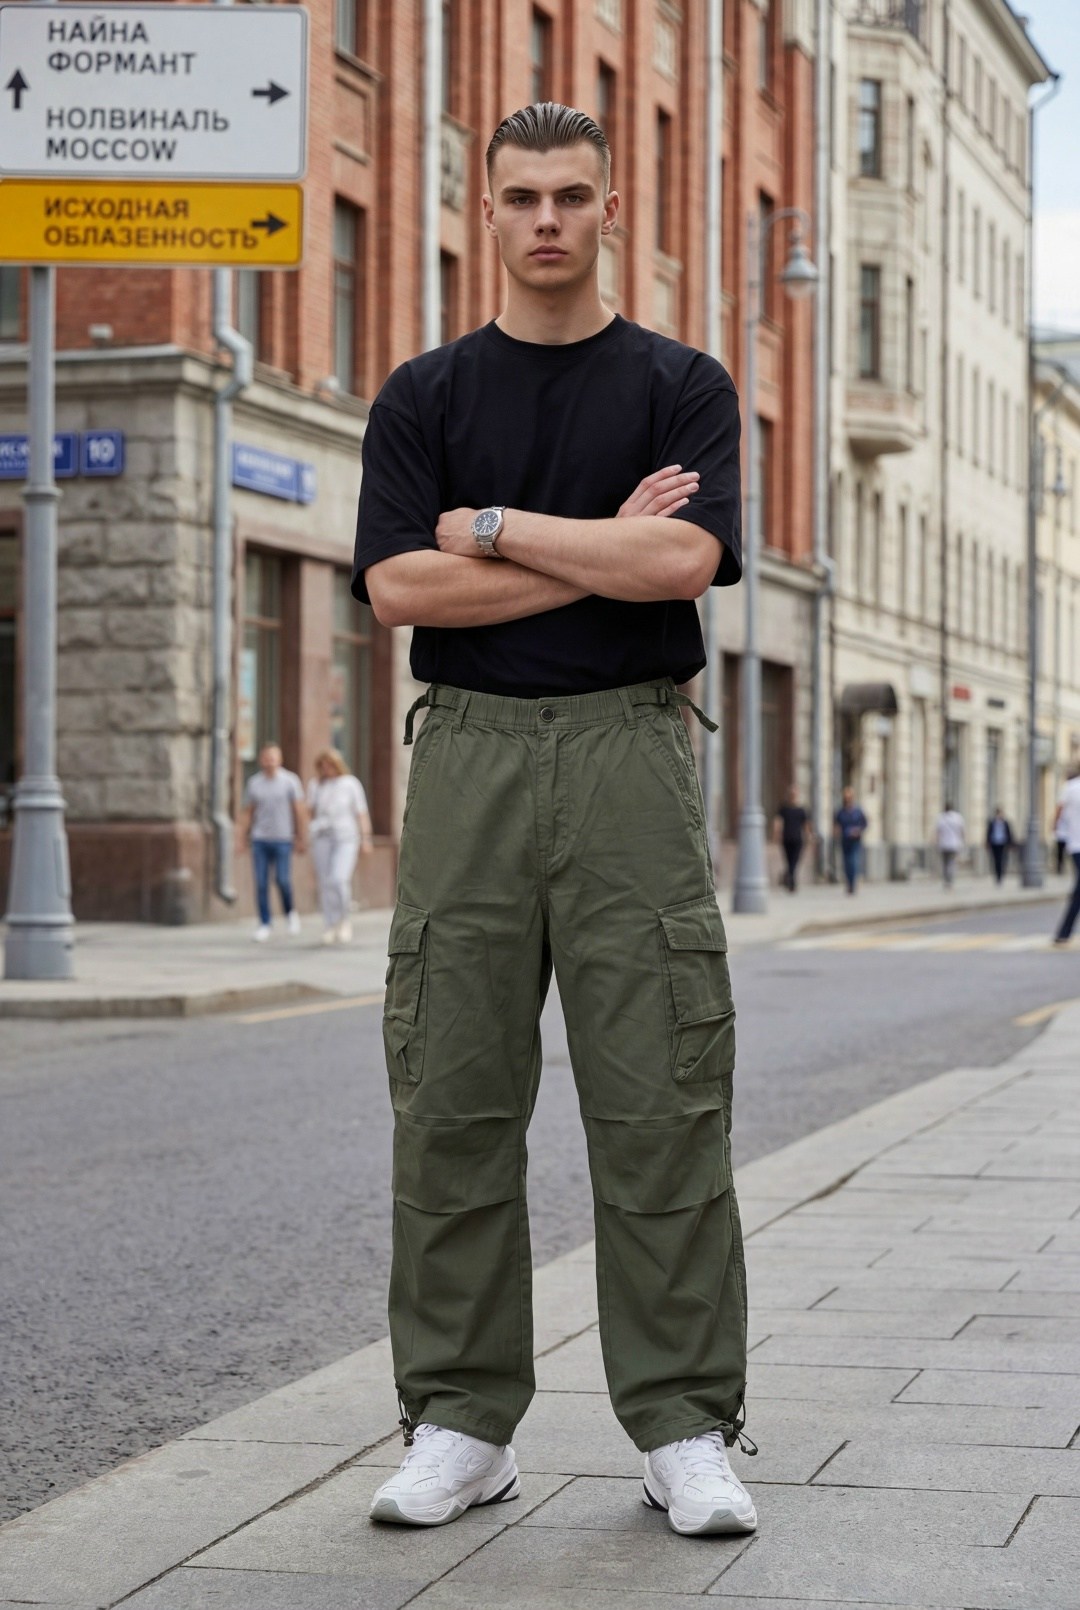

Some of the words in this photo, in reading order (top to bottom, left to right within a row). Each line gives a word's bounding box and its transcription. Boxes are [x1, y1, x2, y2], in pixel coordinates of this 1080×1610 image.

[48, 16, 148, 43] НАЙНА
[48, 51, 195, 74] ФОРМАНТ
[47, 107, 229, 131] НОЛВИНАЛЬ
[45, 198, 188, 221] ИСХОДНАЯ
[44, 226, 259, 249] ОБЛАЗЕННОСТЬ
[88, 438, 115, 463] 10
